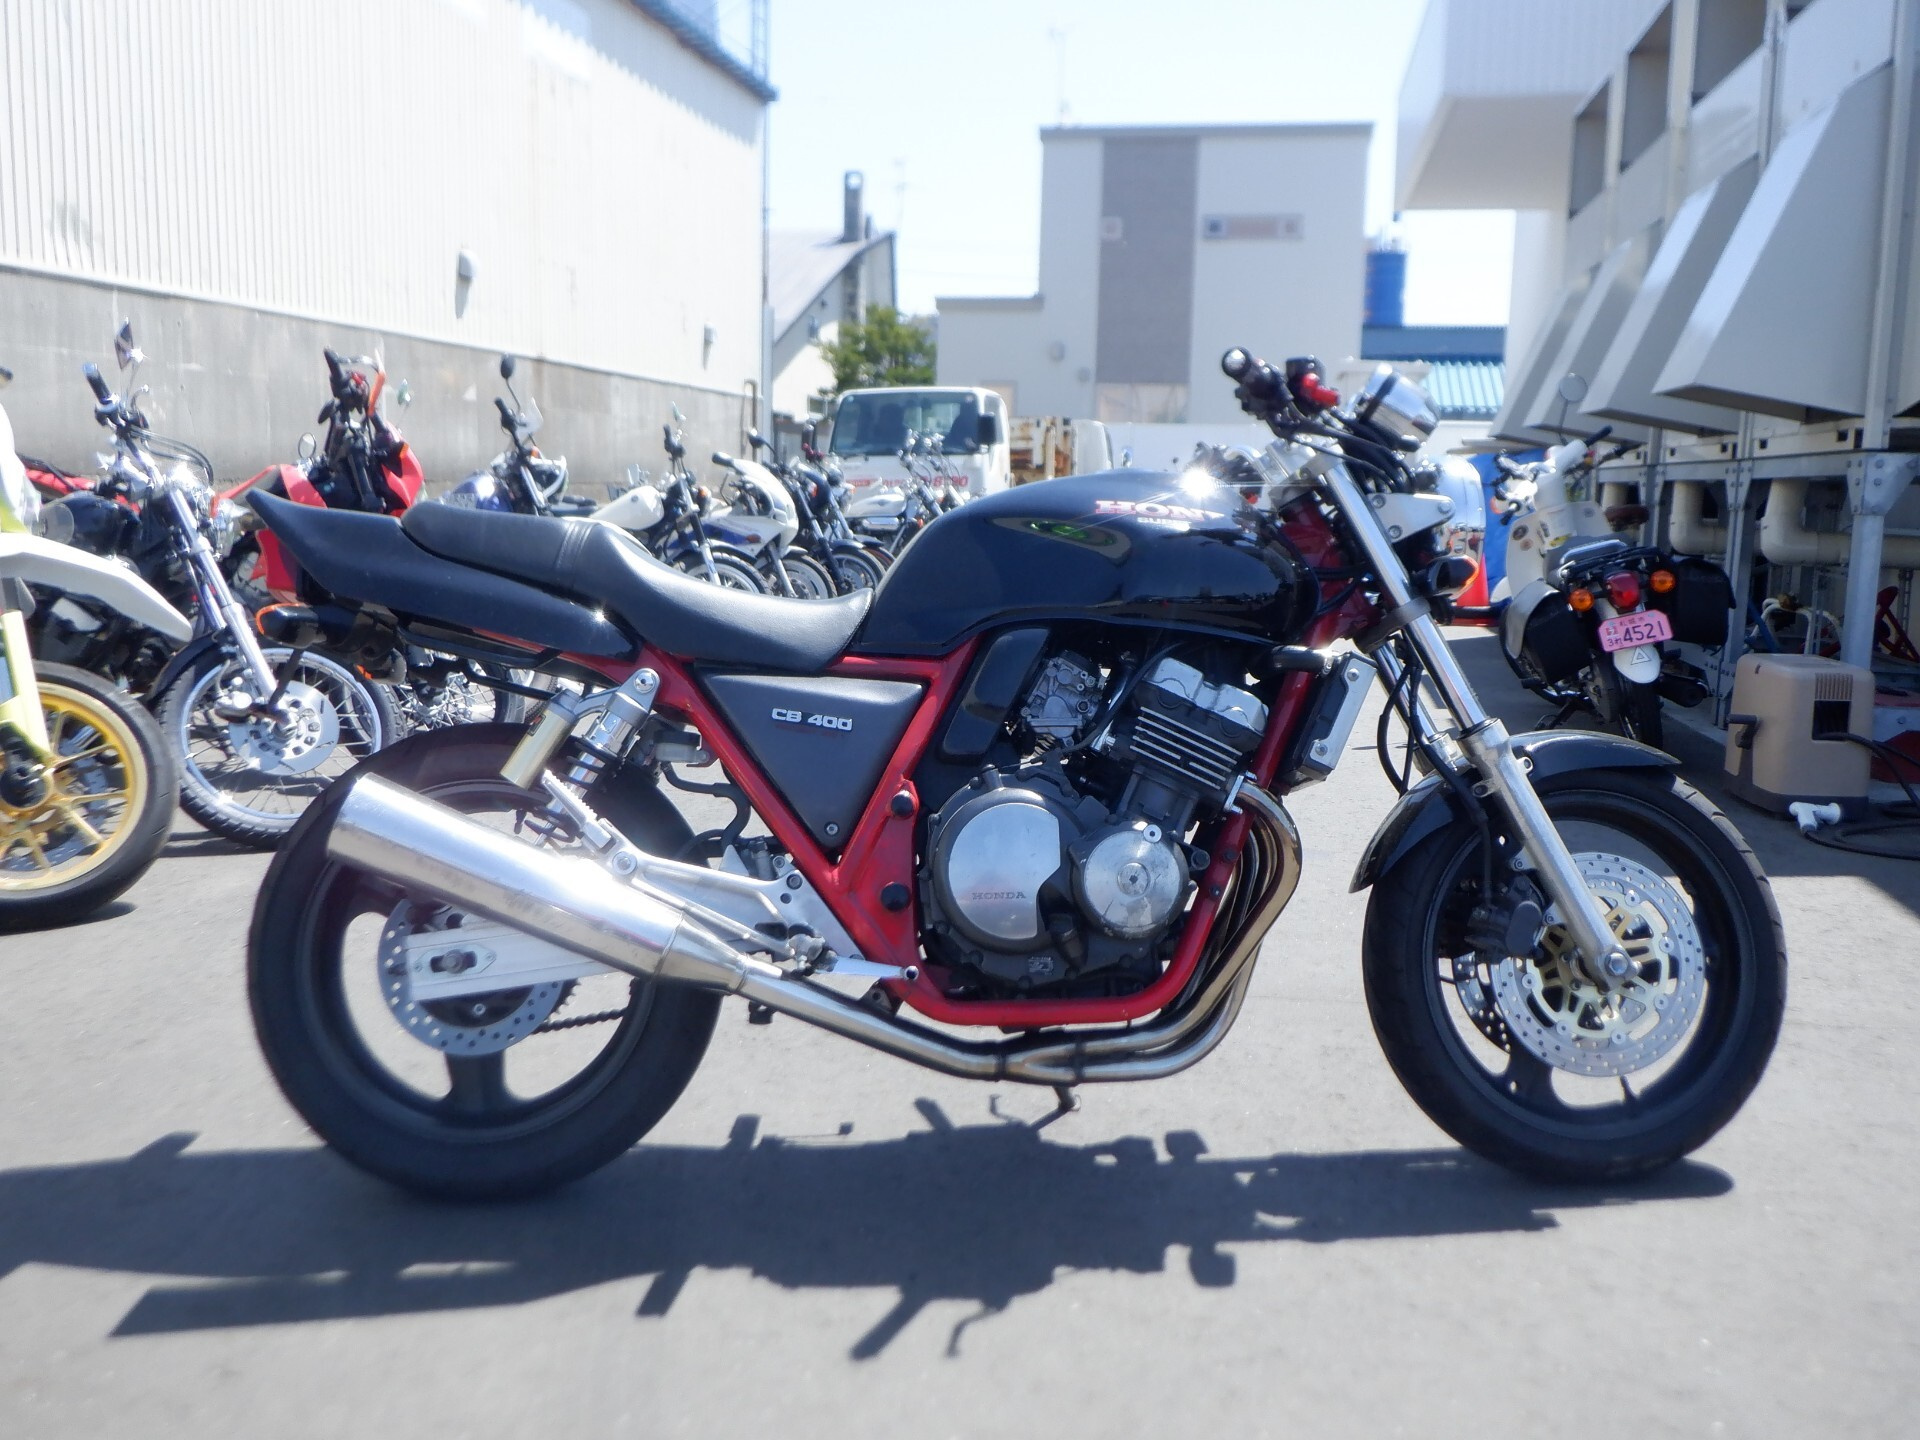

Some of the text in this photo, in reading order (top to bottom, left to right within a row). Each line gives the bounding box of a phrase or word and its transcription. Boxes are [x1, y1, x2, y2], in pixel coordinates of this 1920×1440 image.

[1623, 620, 1664, 643] 4521
[771, 707, 852, 731] CB 400
[972, 891, 1026, 900] HONDA
